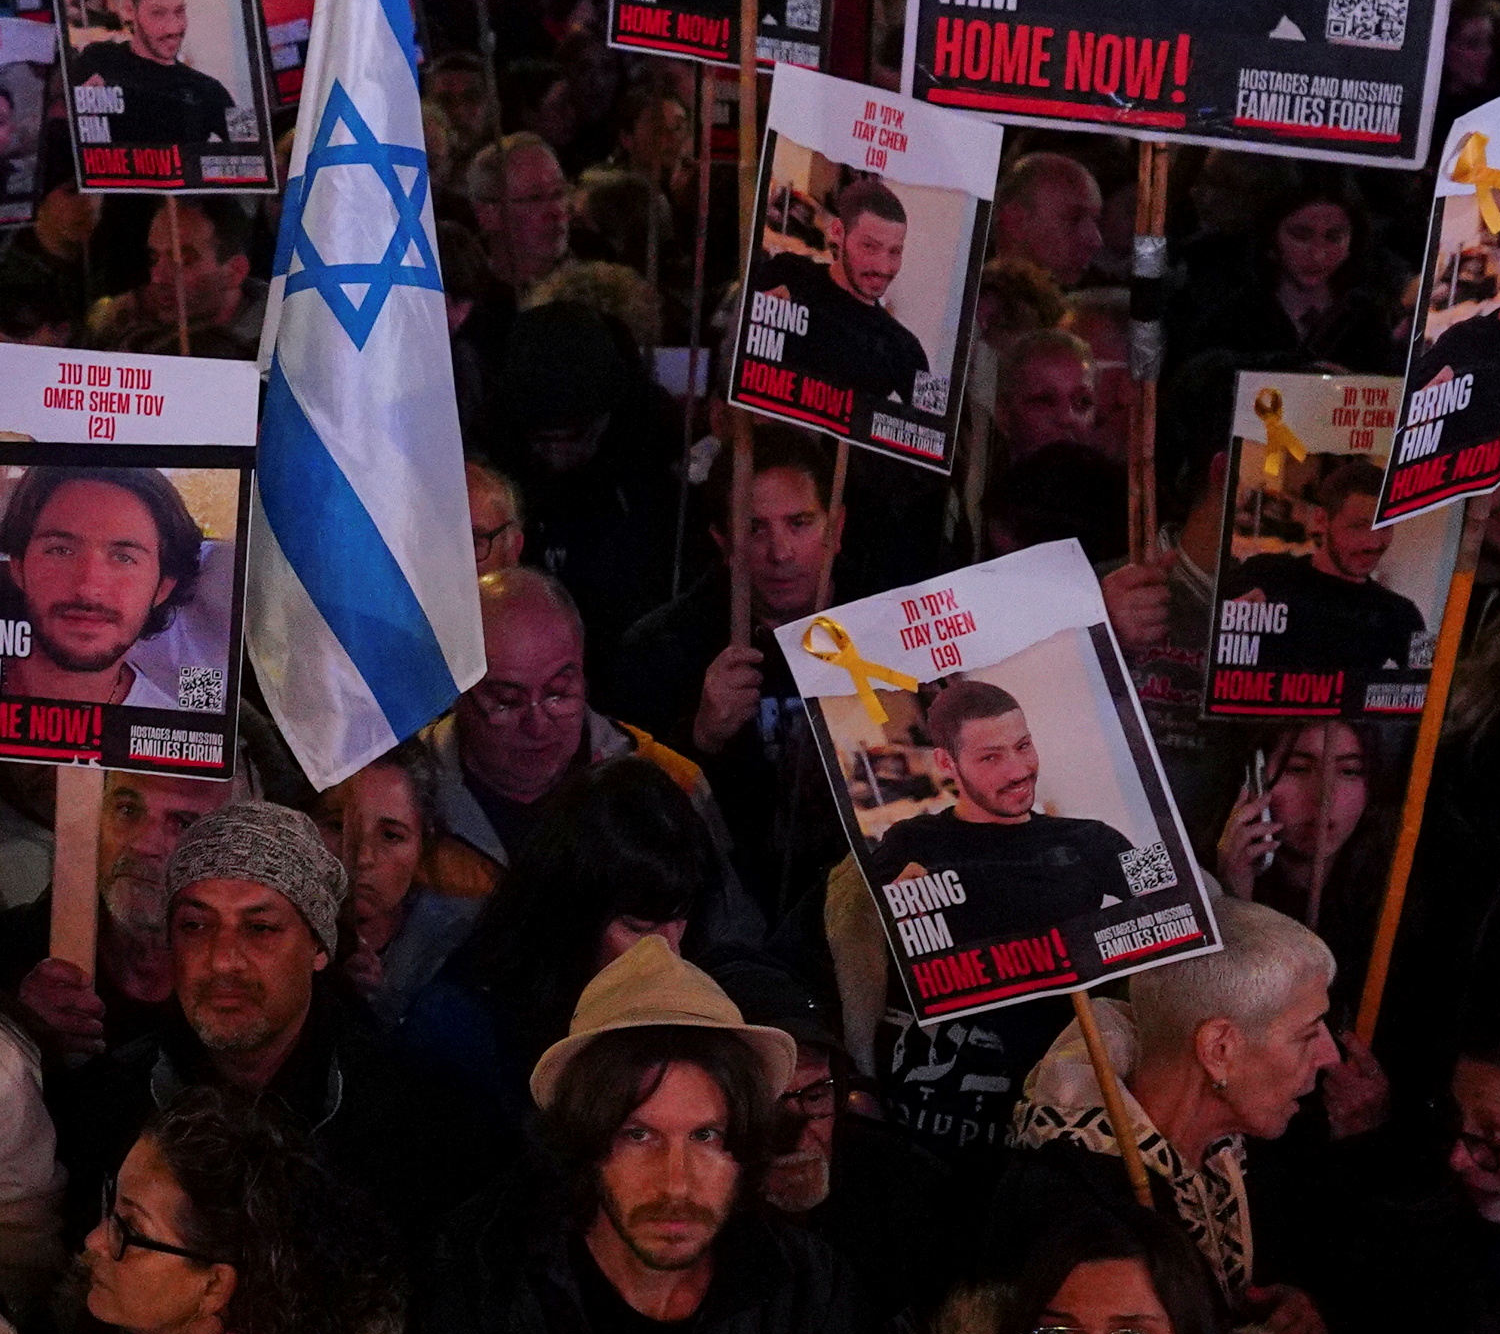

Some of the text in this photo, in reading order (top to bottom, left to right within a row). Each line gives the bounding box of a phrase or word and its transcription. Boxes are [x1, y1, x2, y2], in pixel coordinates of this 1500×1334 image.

[934, 17, 1190, 103] HOME NOW!
[1237, 69, 1403, 105] HOSTAGES AND MISSING
[1236, 91, 1402, 135] FAMILIES FORUM
[853, 120, 907, 152] ITAY CHEN
[866, 146, 887, 170] (19)
[752, 292, 809, 337] BRING
[58, 363, 151, 390] עומר שם טוב
[44, 387, 164, 416] OMER SHEM TOV
[89, 416, 115, 441] (21)
[901, 589, 957, 623] איתי חן
[901, 612, 975, 651] ITAY CHEN
[932, 643, 962, 670] (19)
[30, 706, 102, 745] NOW!
[130, 726, 223, 748] HOSTAGES AND MISSING
[130, 735, 223, 763] FAMILIES FORUM
[883, 870, 966, 918] BRING
[1099, 916, 1197, 958] FAMILIES FORUM
